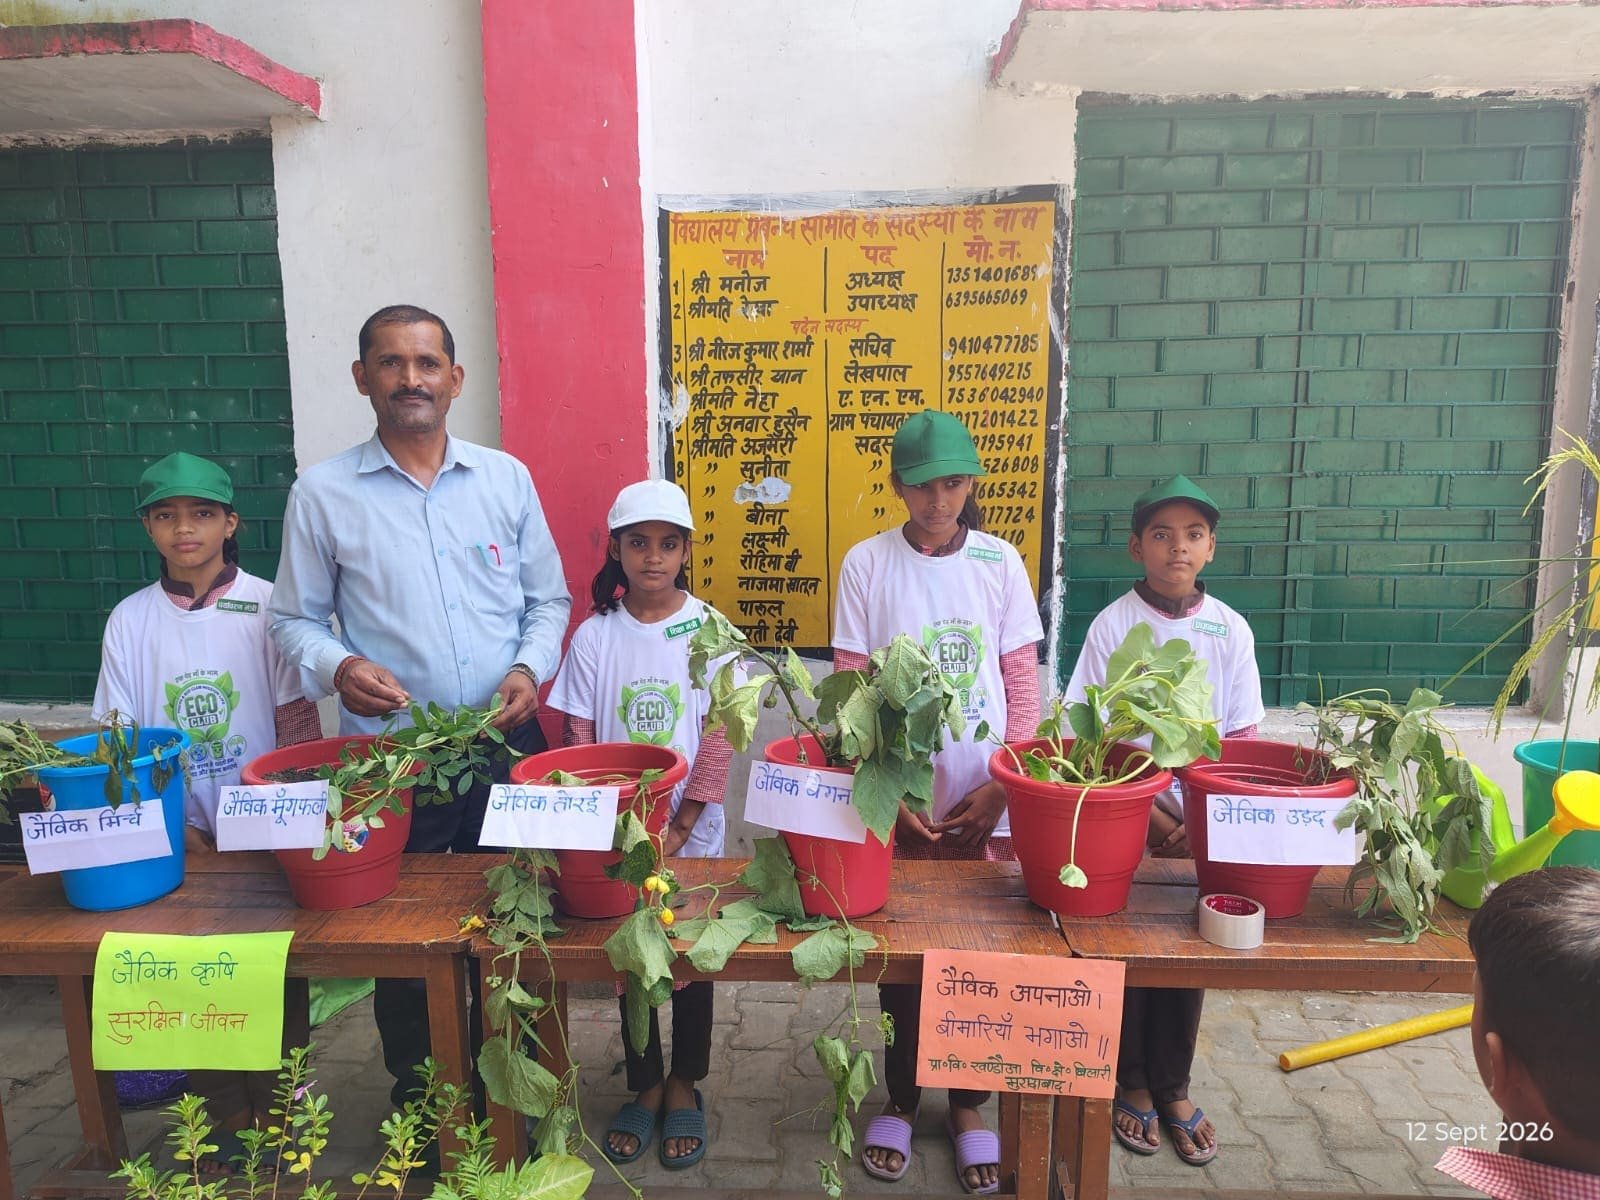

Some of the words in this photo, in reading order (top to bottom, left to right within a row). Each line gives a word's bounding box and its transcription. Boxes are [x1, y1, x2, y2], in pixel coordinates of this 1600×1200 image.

[671, 213, 743, 245] विद्यालय
[963, 206, 986, 233] के
[993, 206, 1046, 234] नाम
[722, 249, 768, 270] नाम
[861, 245, 898, 267] पद
[691, 270, 711, 295] श्री
[718, 269, 771, 294] मनोज
[845, 270, 905, 291] अध्यक्ष
[673, 303, 681, 320] 2
[688, 295, 733, 324] श्रीमति
[848, 293, 918, 313] उपाध्यक्ष
[945, 288, 1028, 309] 6395665069
[673, 344, 682, 363] 3
[689, 336, 706, 362] श्री
[708, 336, 744, 361] नीरज
[744, 341, 780, 363] कुमार
[783, 334, 814, 360] शर्मा
[849, 332, 896, 358] सचिव
[949, 333, 1039, 355] 9410477785
[690, 363, 710, 387] श्री
[711, 362, 763, 388] तफसीर
[770, 369, 807, 385] खान
[844, 359, 912, 383] लेखपाल
[947, 362, 1032, 382] 9557649215
[690, 386, 737, 411] श्रीमति
[744, 385, 779, 412] नेहा
[947, 386, 1044, 404] 7536042940
[691, 409, 716, 433] श्री
[716, 415, 772, 433] अनवार
[773, 406, 812, 436] हुसैन
[829, 413, 857, 432] ग्राम
[675, 439, 683, 455] 7
[690, 432, 737, 459] श्रीमति
[676, 461, 684, 478] 8
[740, 453, 791, 483] सुनीता
[745, 501, 789, 526] बीना
[741, 526, 790, 553] लक्ष्मी
[784, 548, 802, 573] बी
[737, 576, 786, 594] नाजमा
[775, 617, 799, 643] देवी
[940, 642, 968, 662] ECO
[942, 663, 967, 672] CLUB
[185, 693, 218, 717] ECO
[637, 701, 665, 720] ECO
[190, 715, 217, 727] CLUB
[638, 722, 663, 731] CLUB
[755, 763, 799, 796] जैविक
[223, 790, 267, 816] जैविक
[271, 787, 327, 826] मूँगफली
[491, 785, 547, 812] जैविक
[553, 789, 602, 816] तोरई
[1213, 796, 1275, 825] जैविक
[1286, 808, 1326, 828] उड़द
[27, 813, 88, 840] जैविक
[99, 806, 143, 831] मिर्च
[112, 949, 178, 985] जैविक
[190, 951, 238, 986] कृषि
[936, 966, 999, 999] जैविक
[106, 1000, 184, 1045] सुरक्षित
[190, 1003, 248, 1032] जीवन
[935, 1010, 1014, 1043] बीमारियाँ
